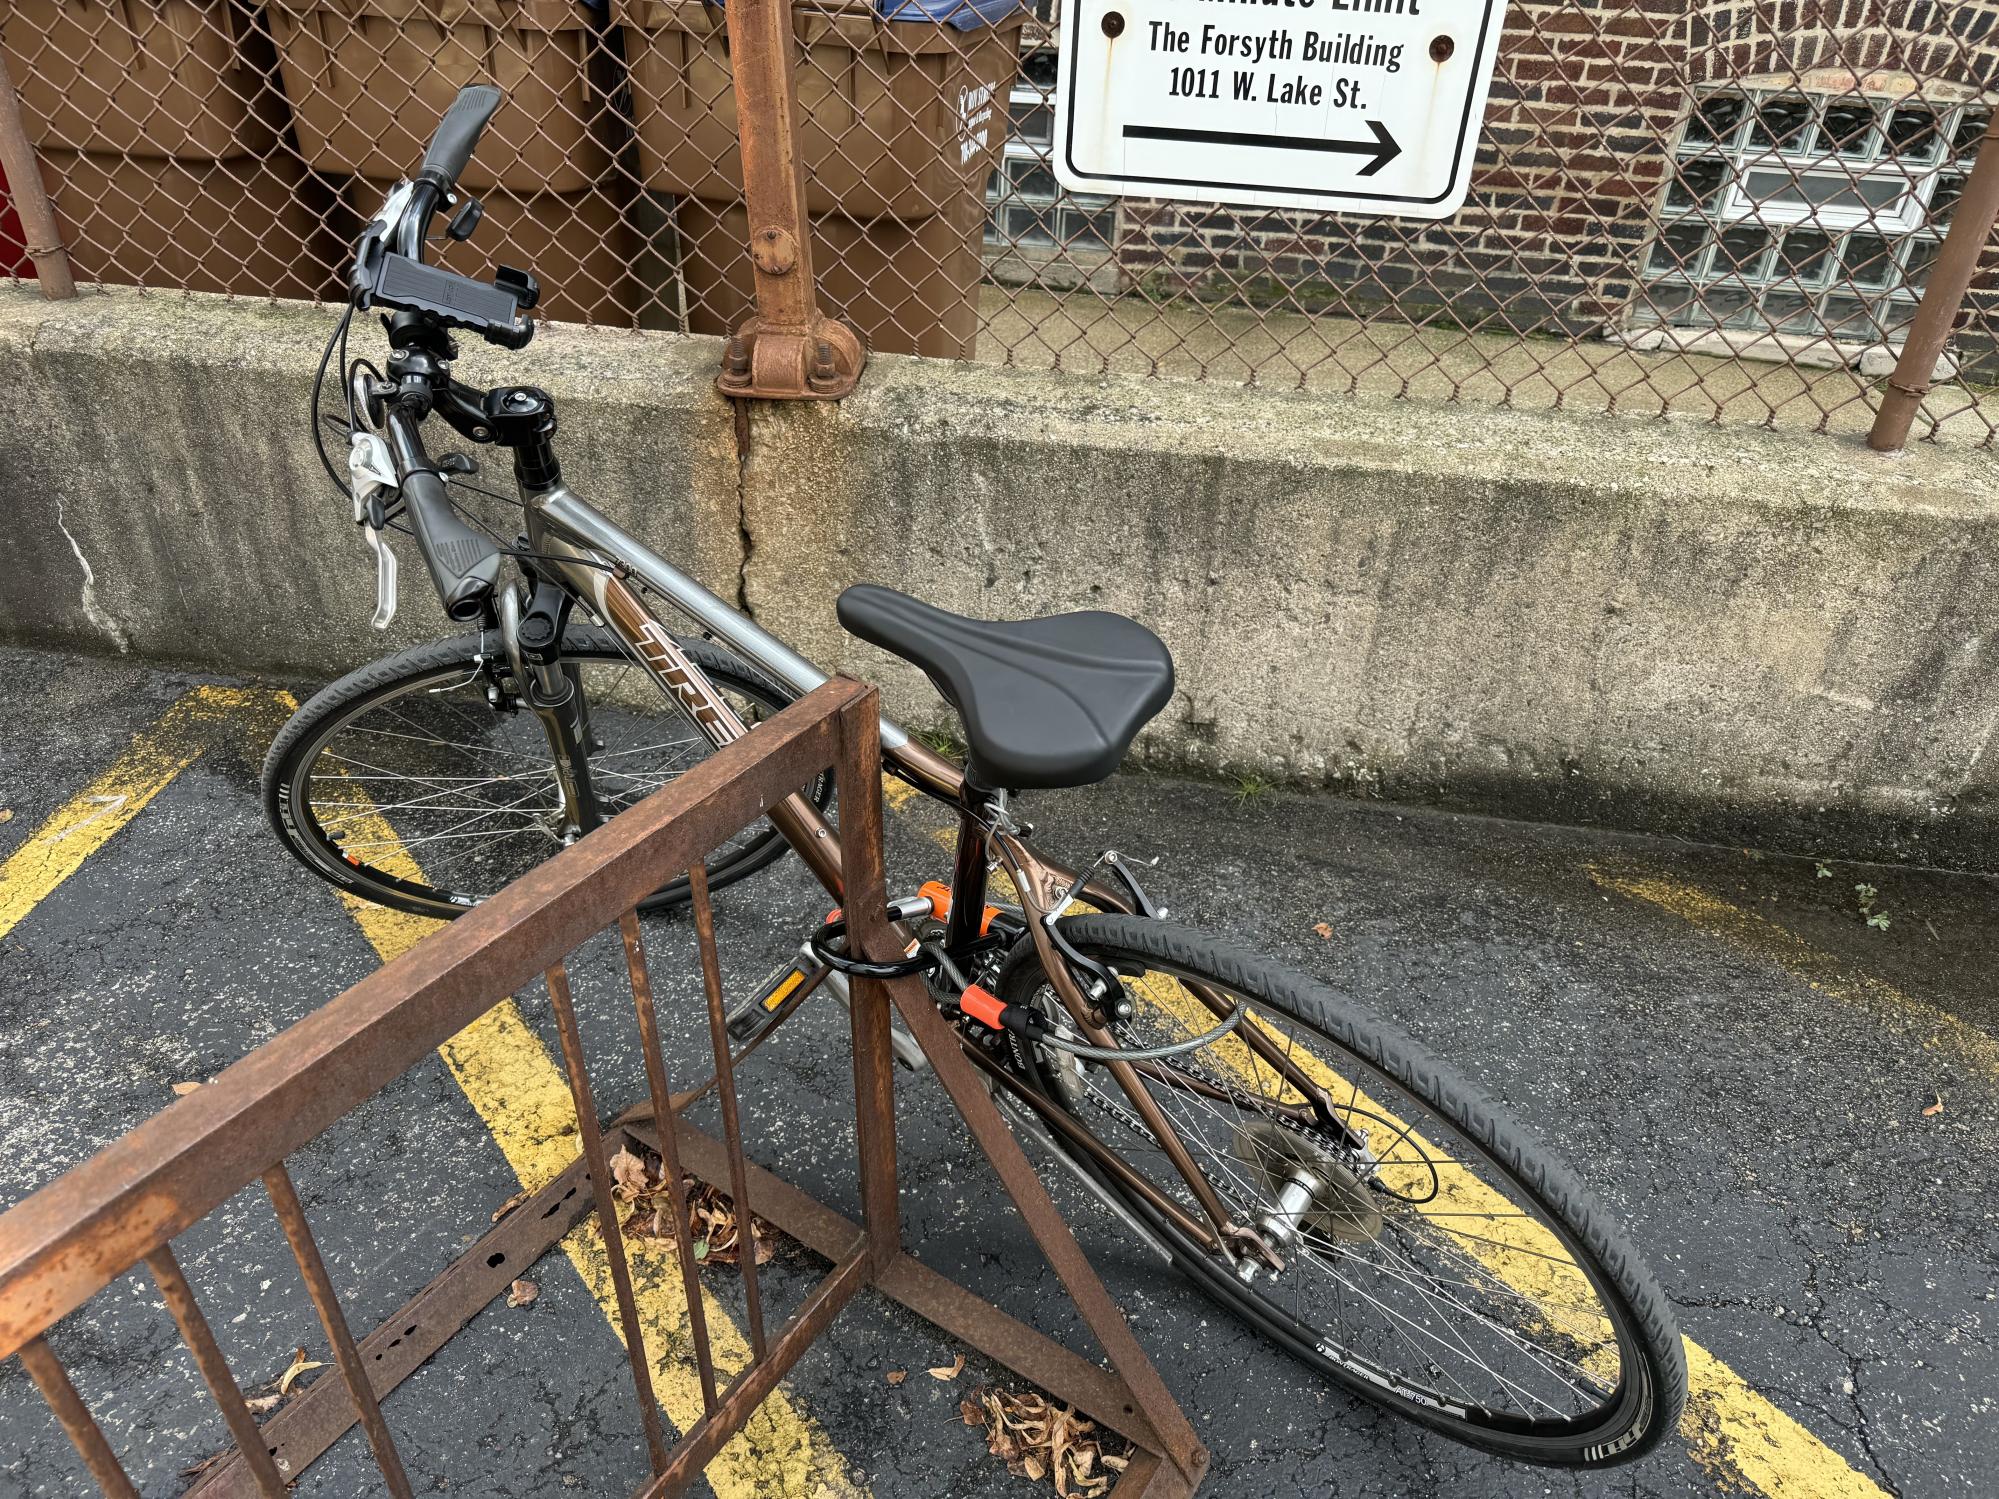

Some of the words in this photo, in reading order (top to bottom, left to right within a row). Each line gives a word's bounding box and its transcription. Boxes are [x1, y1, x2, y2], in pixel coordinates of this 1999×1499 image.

[1149, 21, 1190, 53] The
[1201, 24, 1293, 64] Forsyth
[1302, 31, 1404, 73] Building
[1169, 67, 1220, 98] 1011
[1233, 71, 1257, 101] W.
[1266, 73, 1322, 106] Lake
[1333, 78, 1367, 110] St.
[635, 622, 738, 749] TRE
